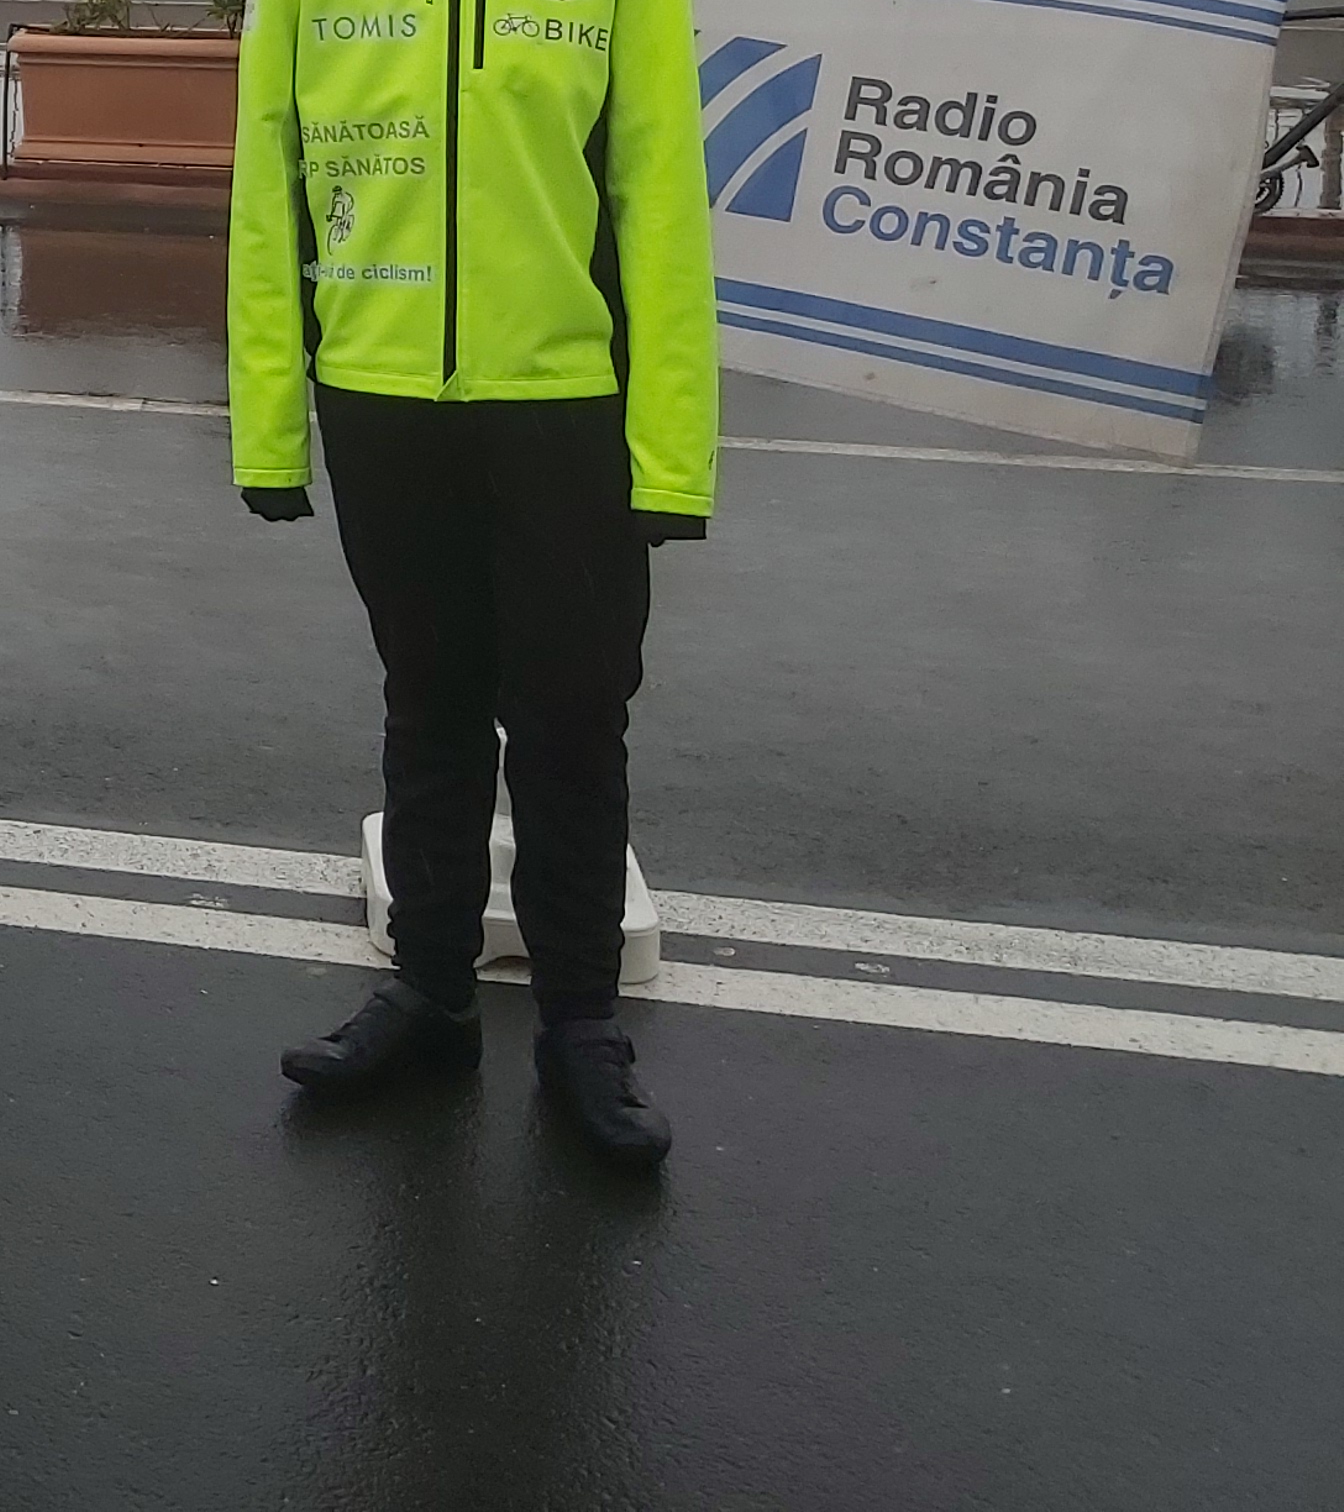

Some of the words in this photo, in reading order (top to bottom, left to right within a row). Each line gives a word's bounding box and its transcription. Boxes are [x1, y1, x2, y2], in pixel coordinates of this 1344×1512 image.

[311, 14, 417, 41] TOMIS
[544, 18, 609, 51] BIKE
[843, 76, 1037, 146] Radio
[303, 115, 430, 143] SĂNĂTOASĂ
[325, 154, 426, 178] SĂNĂTOS
[833, 129, 1129, 225] România
[821, 185, 1176, 300] Constanța
[336, 264, 356, 280] de
[361, 263, 433, 282] ciclism!
